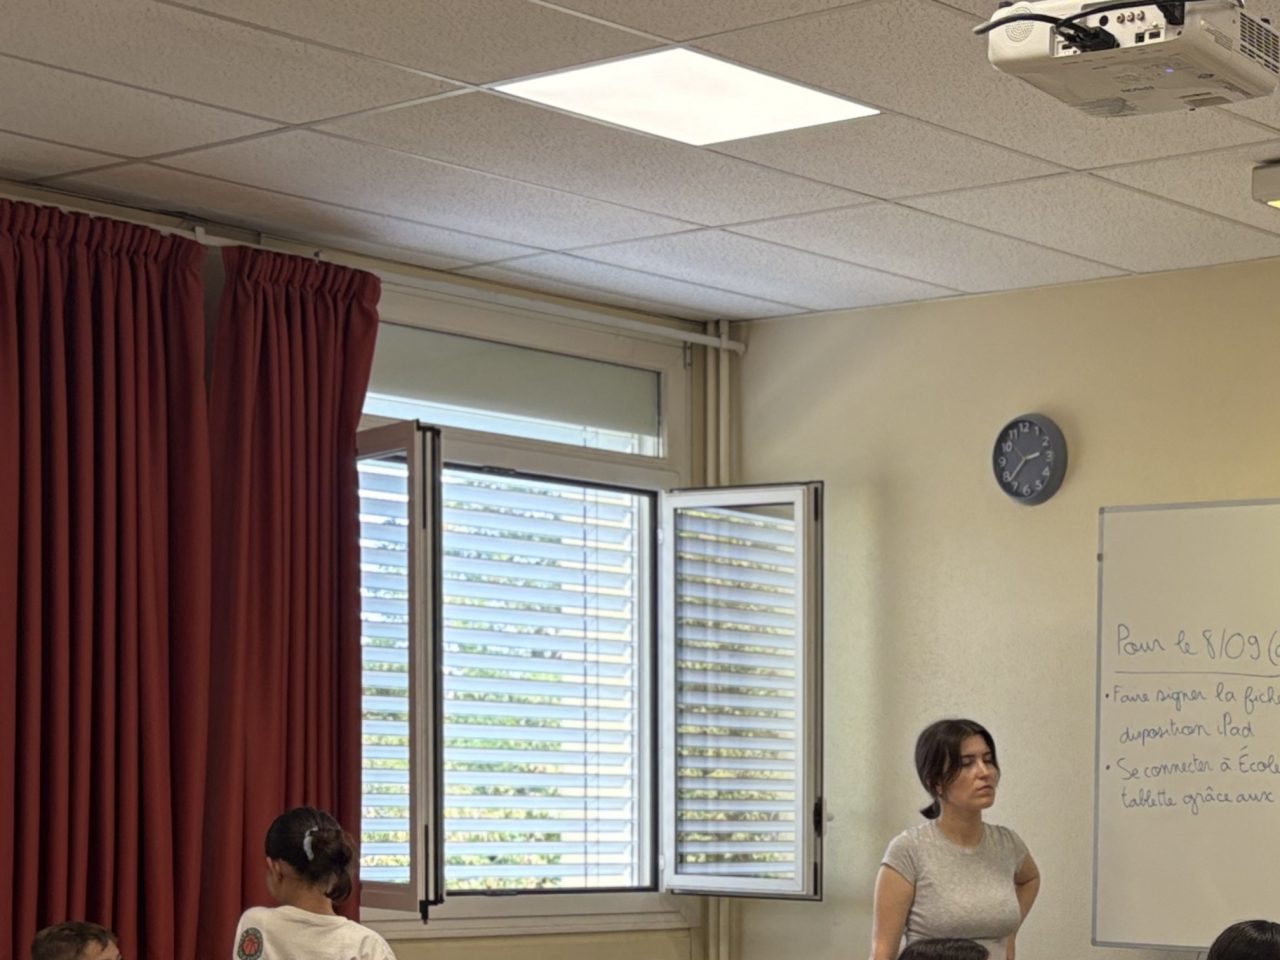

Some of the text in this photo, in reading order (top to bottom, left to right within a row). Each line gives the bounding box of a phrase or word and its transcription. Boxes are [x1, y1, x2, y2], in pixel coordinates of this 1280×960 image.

[1018, 422, 1030, 432] 12
[1034, 426, 1040, 436] 1
[1008, 429, 1018, 440] 11
[1001, 441, 1013, 452] 10
[1041, 436, 1049, 446] 2
[1045, 450, 1053, 461] 3
[998, 457, 1007, 467] 9
[1002, 471, 1011, 482] 8
[1041, 466, 1050, 476] 4
[1011, 482, 1018, 491] 7
[1022, 484, 1031, 496] 6
[1034, 480, 1042, 490] 5
[1117, 623, 1166, 656] Pour
[1174, 629, 1198, 656] le
[1202, 628, 1261, 661] 8/09
[1113, 685, 1150, 703] Faire
[1156, 689, 1206, 712] signer
[1215, 681, 1237, 702] la
[1119, 719, 1211, 747] disposition
[1116, 757, 1140, 780] Se
[1144, 753, 1213, 778] connecter
[1220, 757, 1232, 772] à
[1121, 786, 1177, 809] tablette
[1183, 786, 1232, 815] grâce
[1236, 791, 1273, 804] aux
